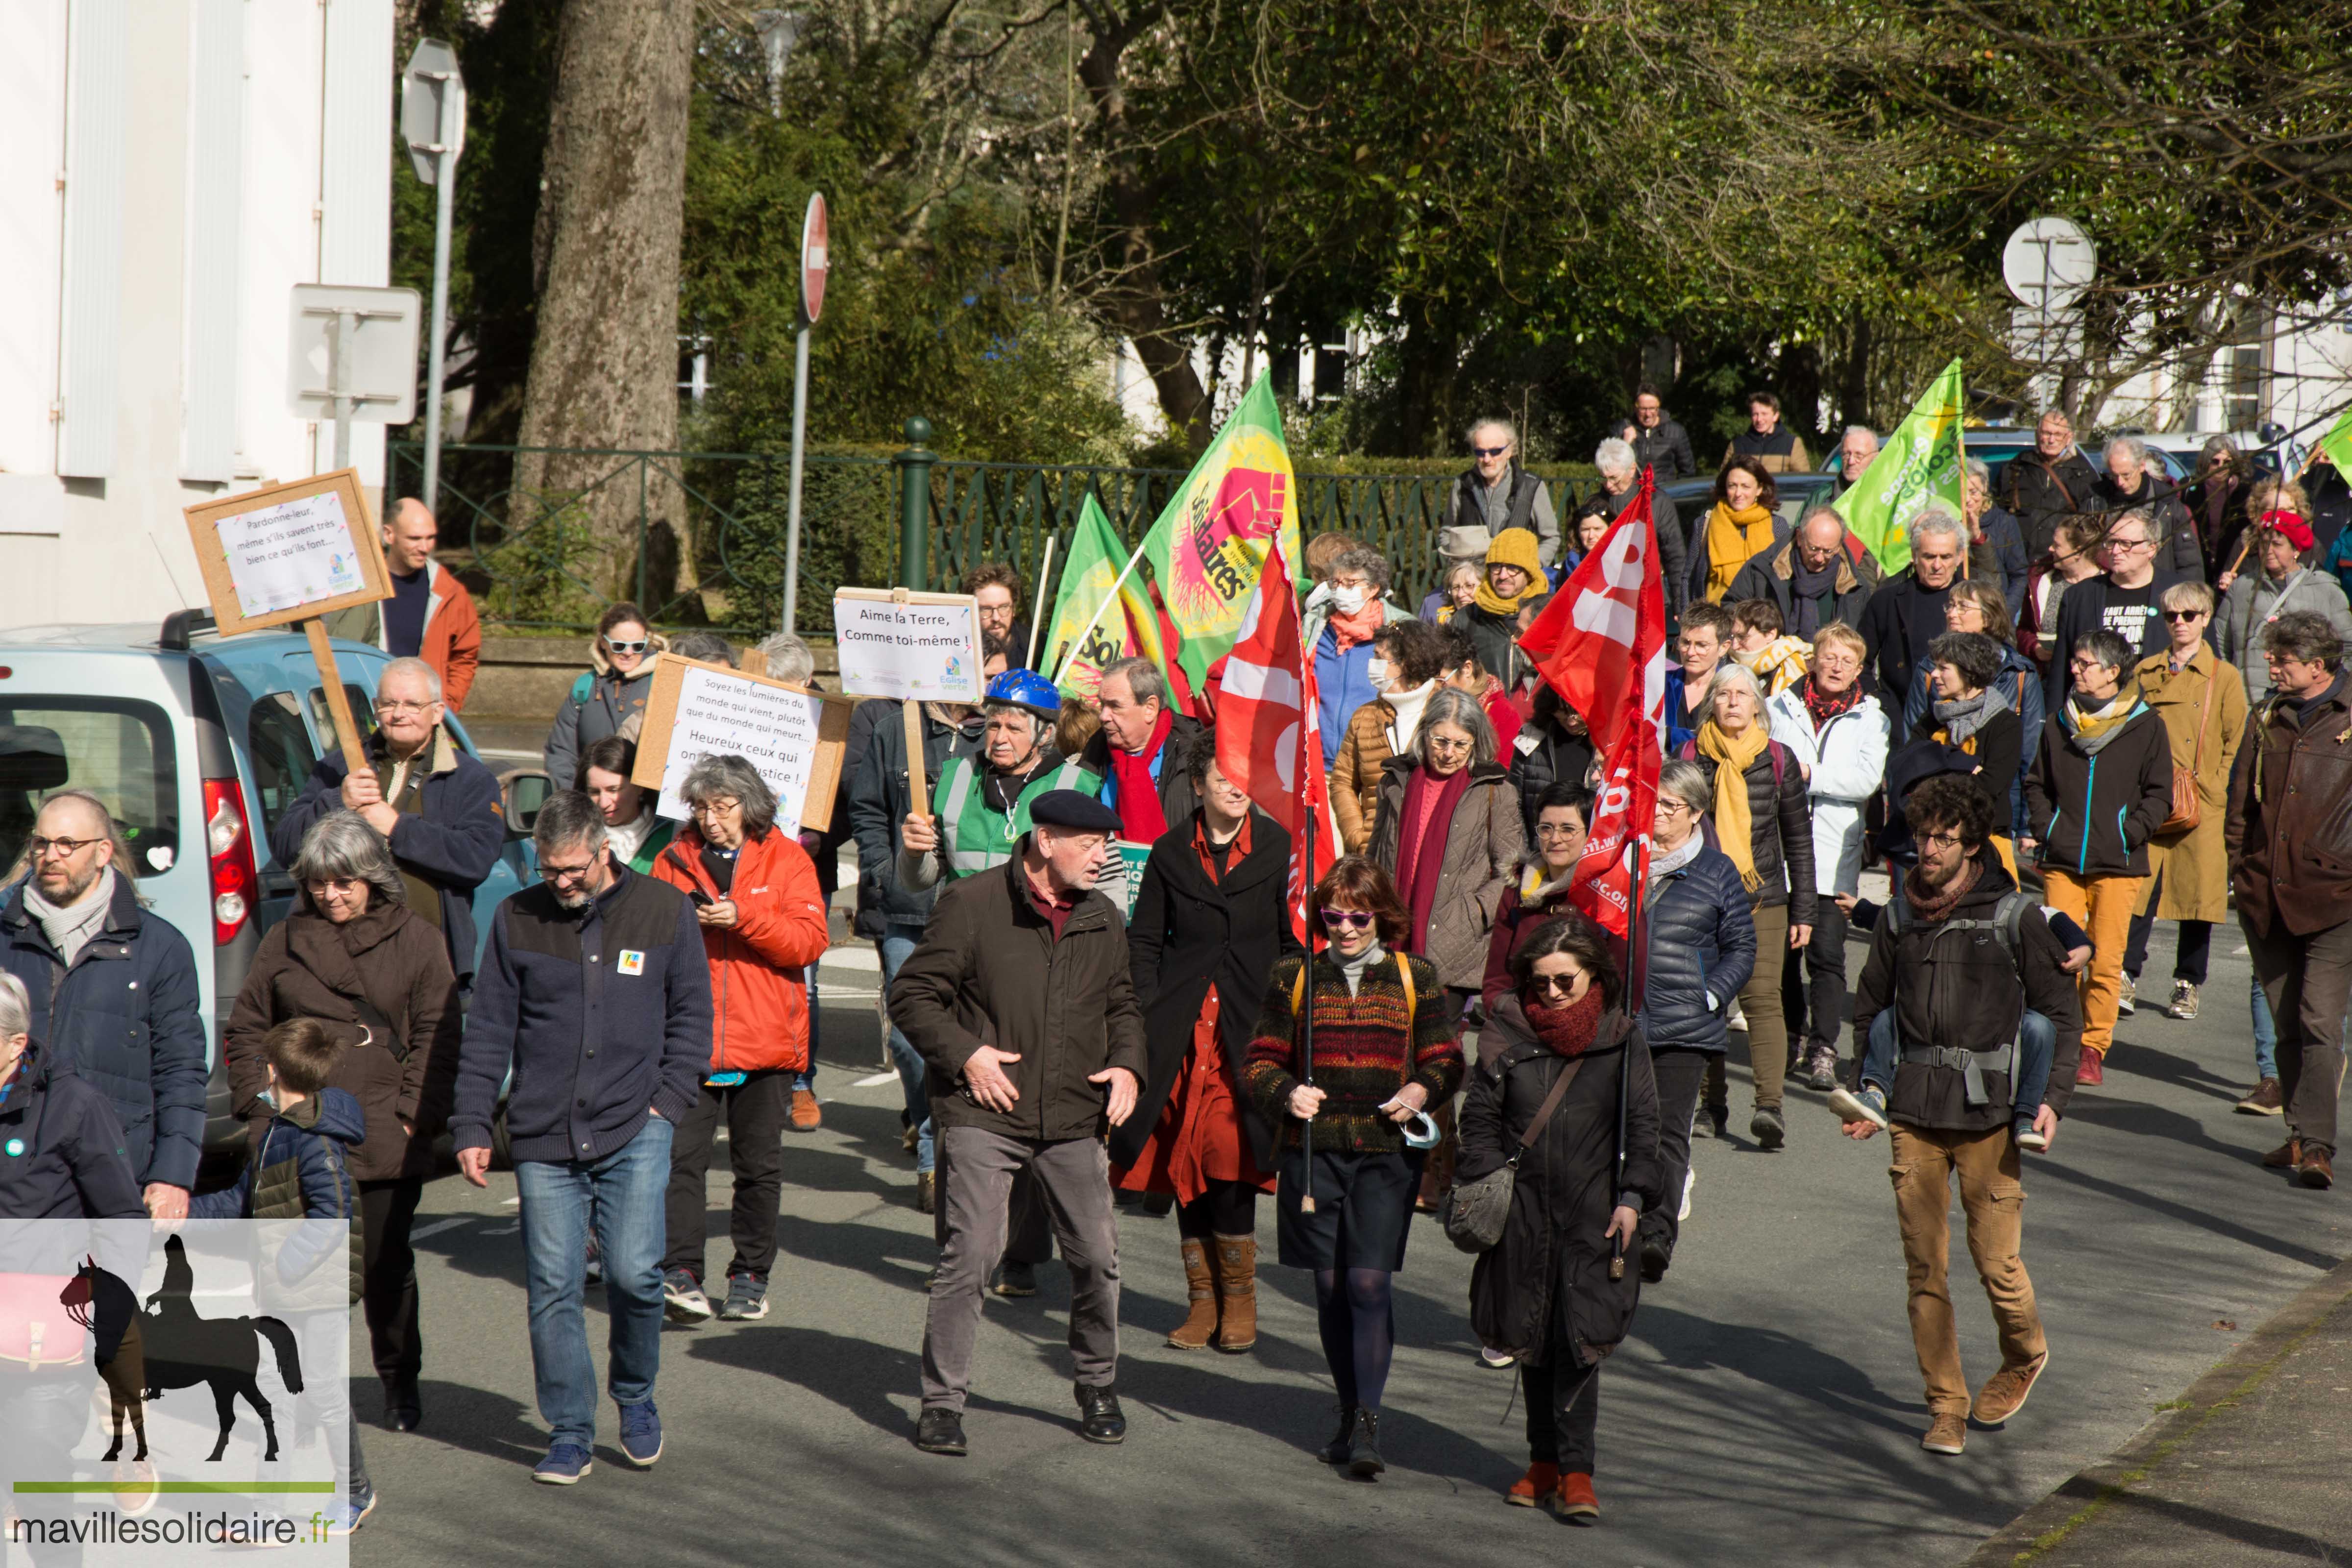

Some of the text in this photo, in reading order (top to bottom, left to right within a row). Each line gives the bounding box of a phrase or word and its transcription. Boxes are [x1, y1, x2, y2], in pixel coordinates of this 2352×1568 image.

[246, 508, 314, 529] Pardonne-leur,
[237, 519, 335, 551] même s'ils savent très
[246, 554, 266, 565] bien
[268, 551, 278, 560] ce
[281, 543, 306, 558] qu'ils
[1230, 551, 1255, 584] syndicale
[1238, 543, 1254, 567] Union
[860, 610, 950, 626] Aime la Terre,
[2103, 606, 2124, 616] FAUT
[845, 629, 968, 646] Comme toi-même !
[1078, 624, 1122, 667] Sol
[705, 679, 804, 709] Soyez les lumières du
[696, 695, 807, 726] monde qui vient, plutôt
[686, 708, 810, 742] que du monde qui meurt...
[689, 730, 799, 763] Heureux ceux qui
[795, 773, 799, 784] !
